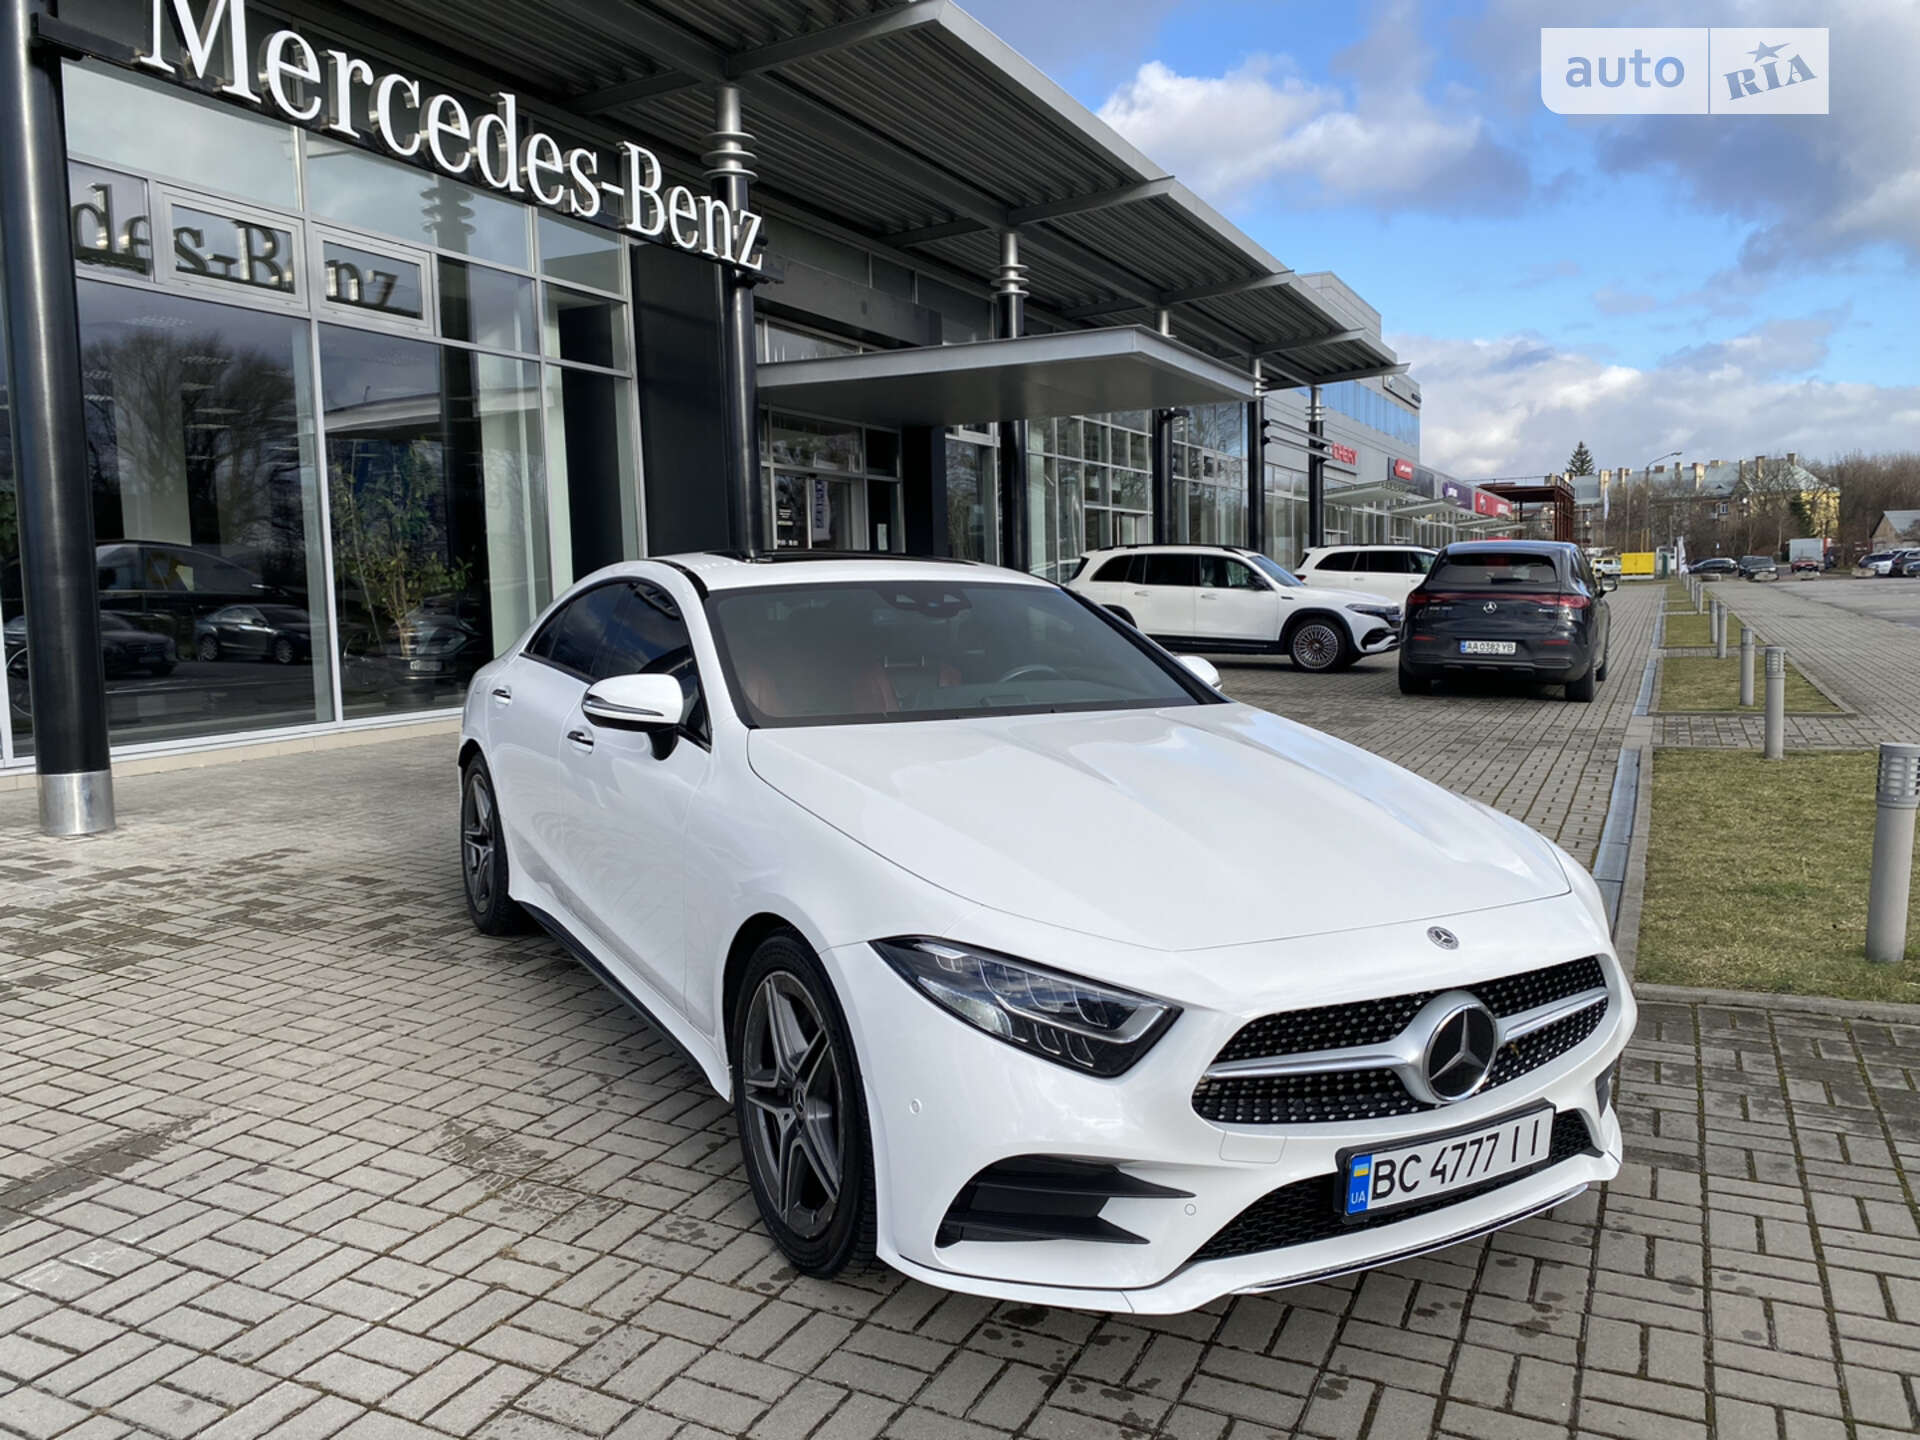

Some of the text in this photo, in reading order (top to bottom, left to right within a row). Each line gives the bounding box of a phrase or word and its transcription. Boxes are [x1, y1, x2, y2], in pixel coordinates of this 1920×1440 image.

[139, 0, 763, 271] Mercedes-Benz
[1351, 1190, 1366, 1204] UA
[1372, 1154, 1422, 1200] BC
[1430, 1132, 1500, 1185] 4777
